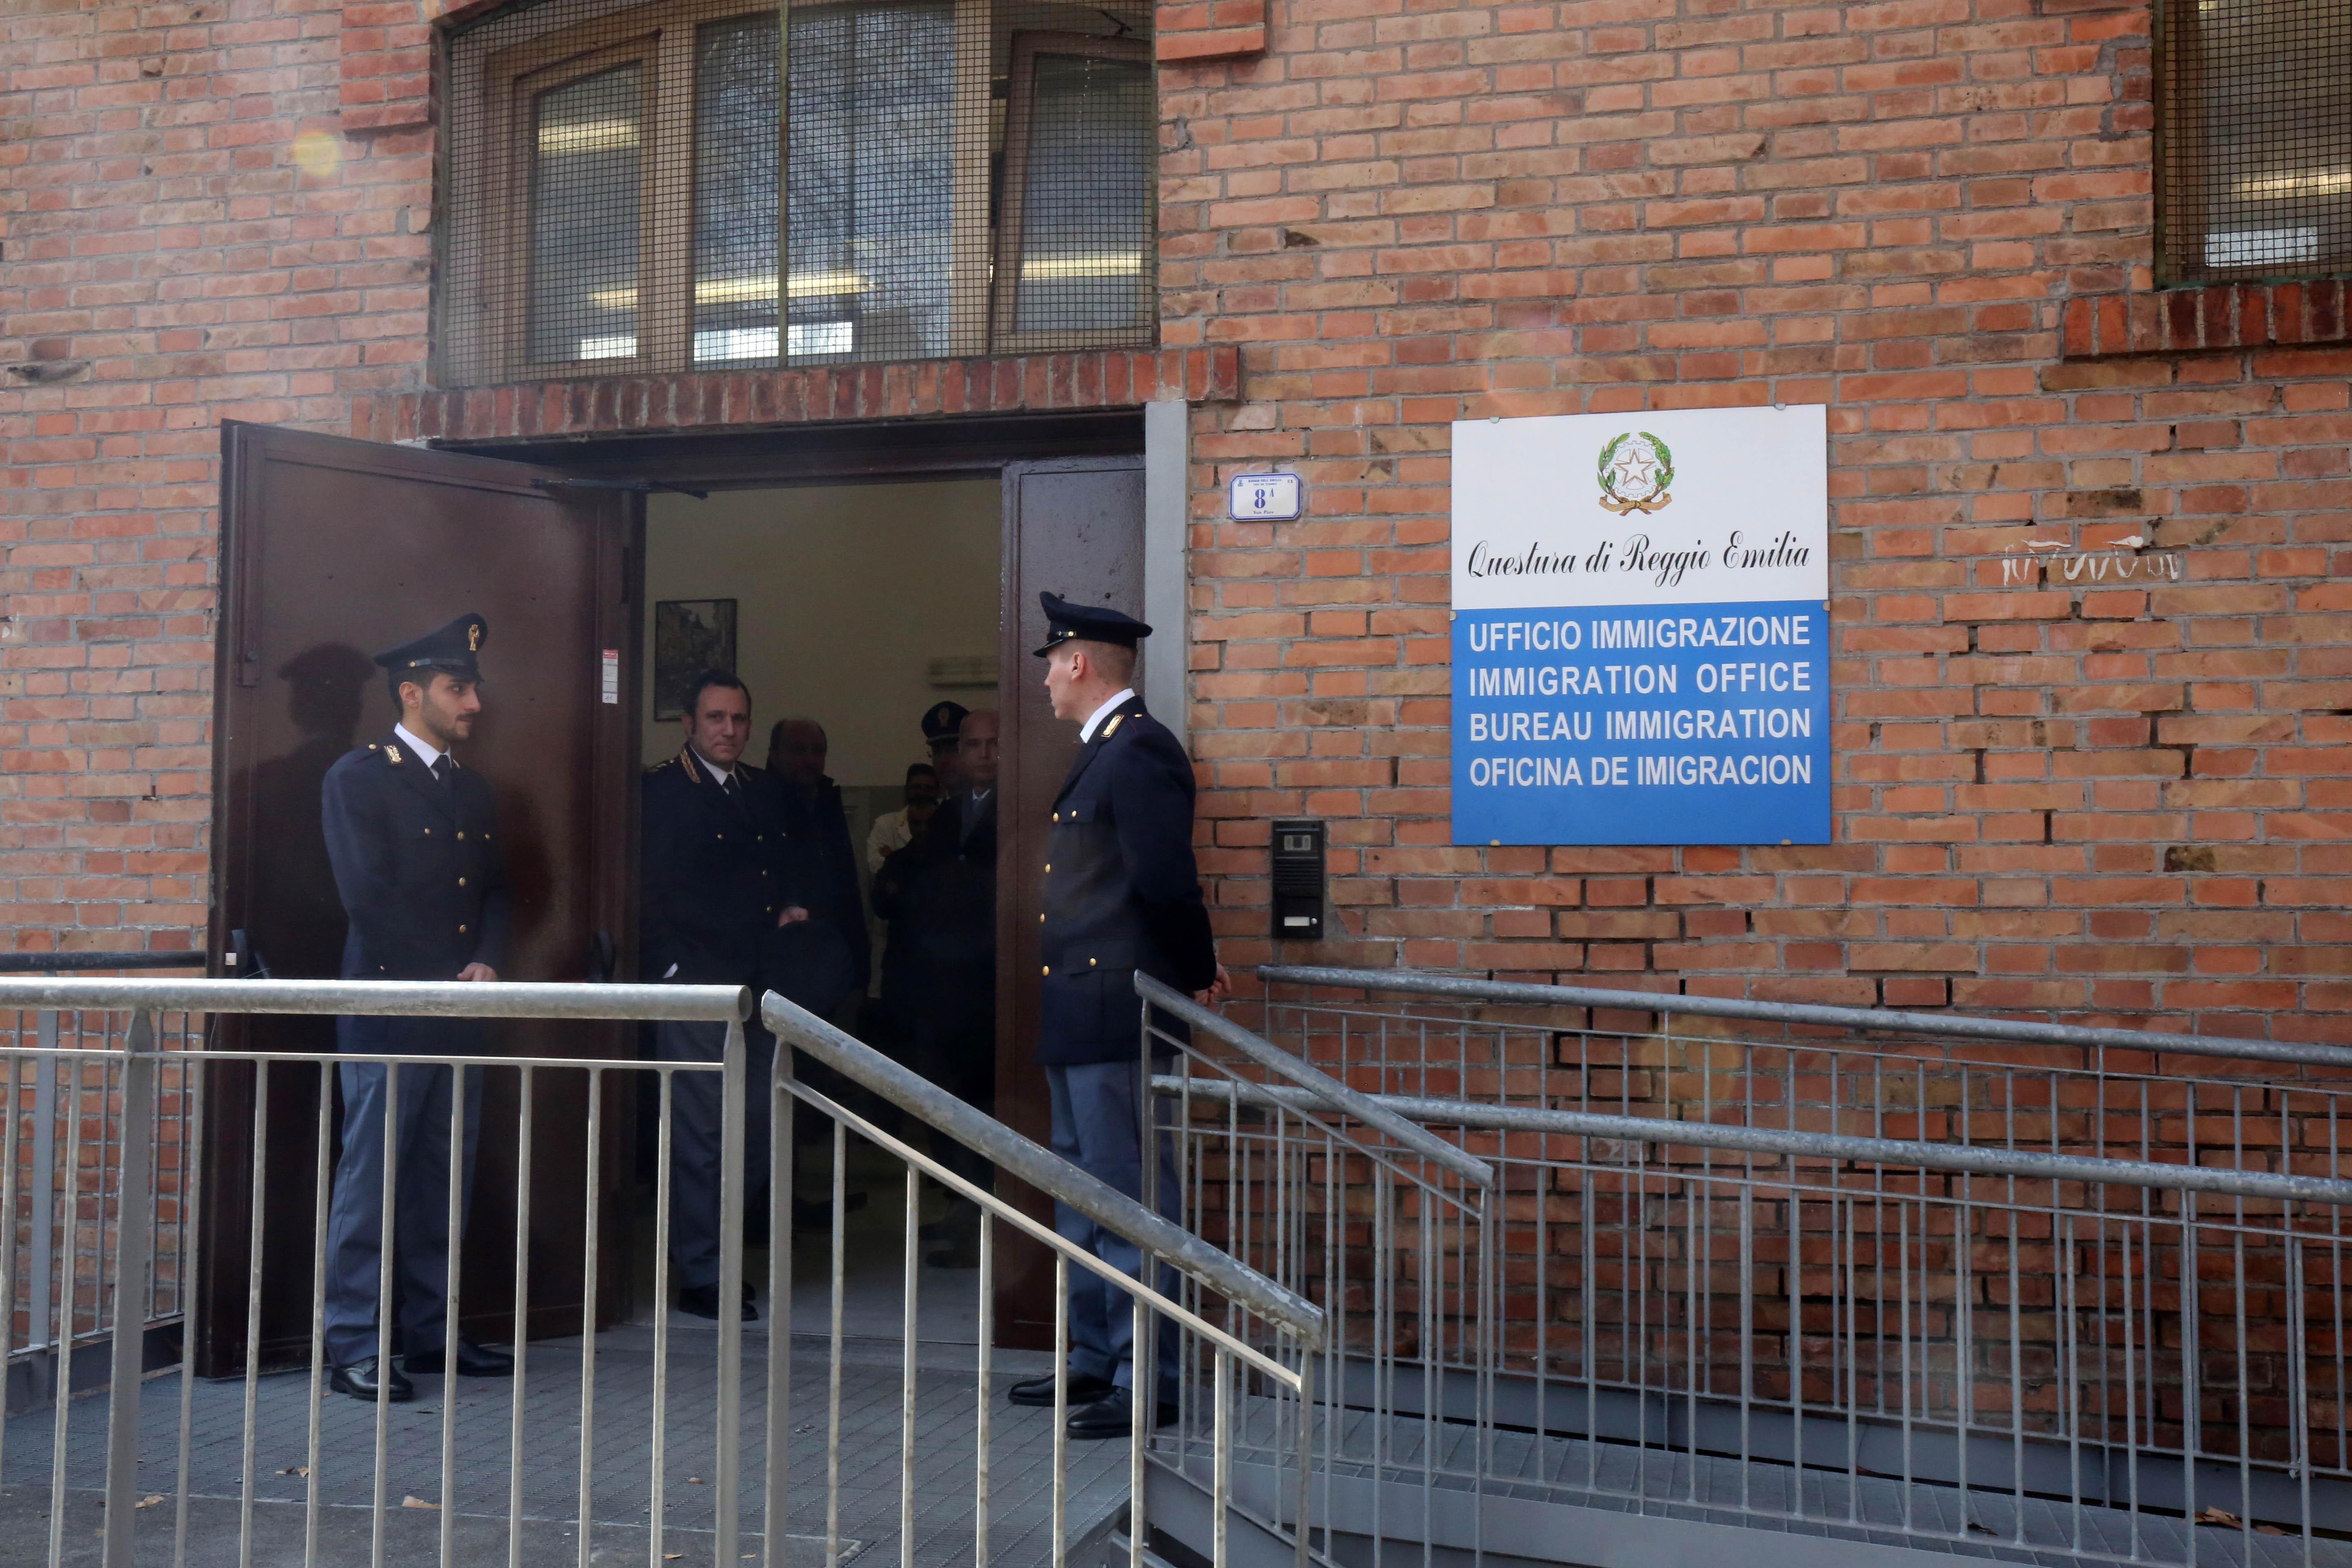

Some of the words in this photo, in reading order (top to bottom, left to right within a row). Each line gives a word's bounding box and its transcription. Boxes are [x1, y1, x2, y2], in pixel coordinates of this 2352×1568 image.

[1255, 489, 1265, 508] 8
[1269, 488, 1274, 497] A
[1468, 540, 1577, 578] Questura
[1585, 541, 1613, 573] di
[1619, 533, 1711, 588] Reggio
[1723, 530, 1809, 568] Emilia
[1470, 621, 1581, 652] UFFICIO
[1592, 615, 1810, 649] IMMIGRAZIONE
[1470, 665, 1677, 696] IMMIGRATION
[1696, 662, 1811, 693] OFFICE
[1470, 712, 1591, 741] BUREAU
[1606, 708, 1810, 739] IMMIGRATION
[1470, 757, 1583, 786] OFICINA
[1591, 756, 1628, 785] DE
[1638, 755, 1811, 785] IMIGRACION
